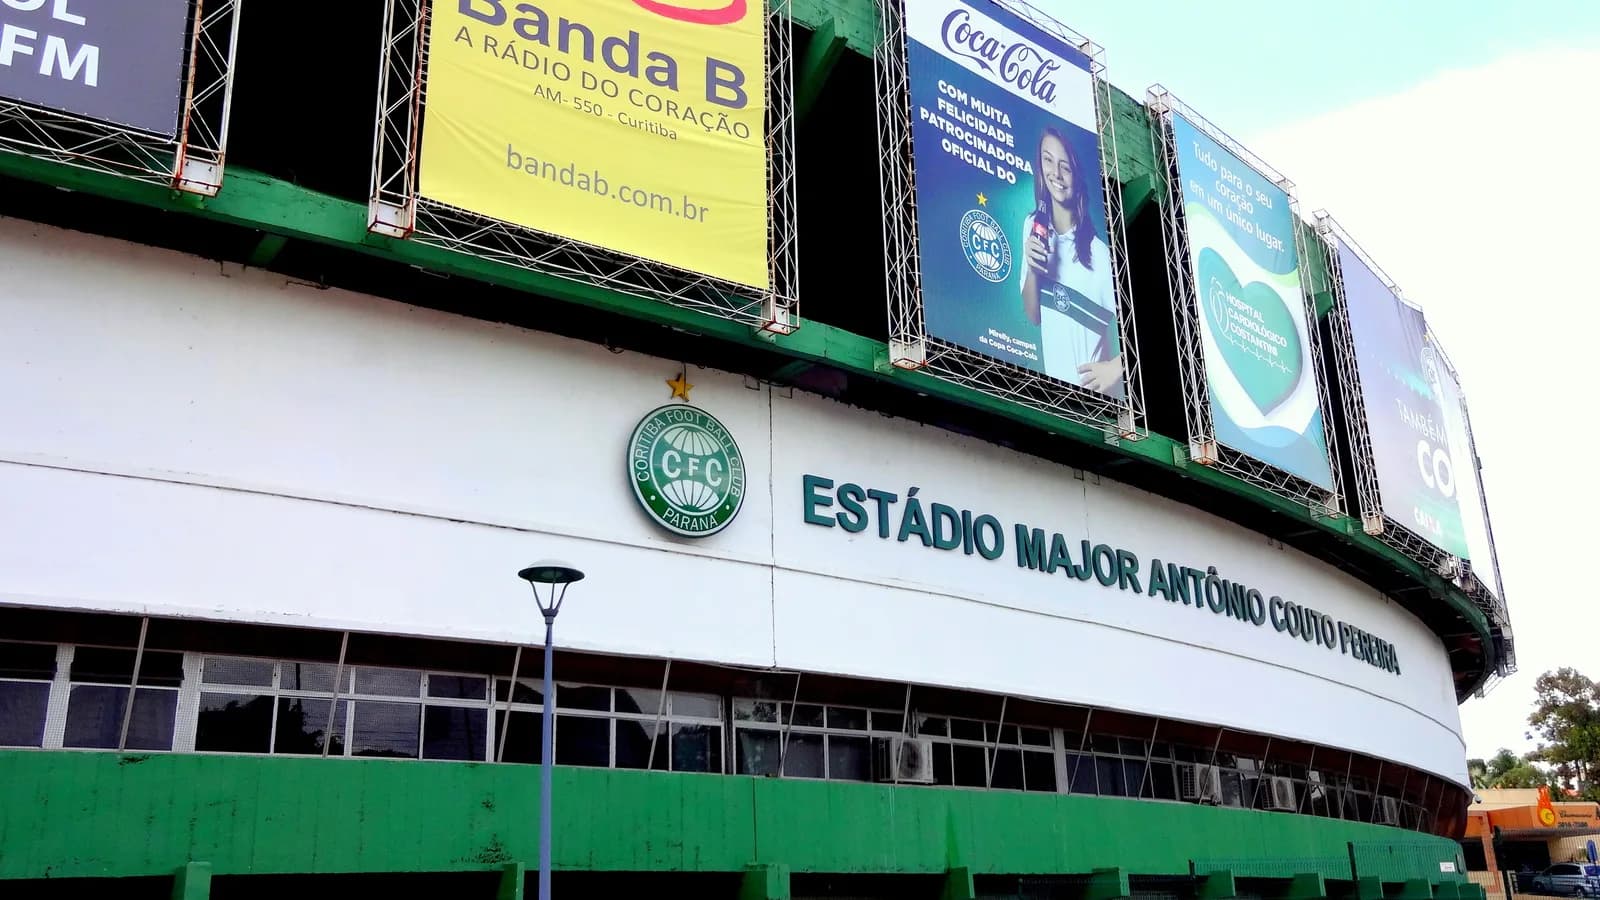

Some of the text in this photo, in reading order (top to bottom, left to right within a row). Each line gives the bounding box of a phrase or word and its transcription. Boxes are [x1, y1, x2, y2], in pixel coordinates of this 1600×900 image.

[1, 0, 86, 26] L
[0, 24, 99, 87] FM
[941, 9, 1061, 104] Coca-Cola
[454, 26, 750, 140] A RÁDIO DO CORAÇÃO
[706, 57, 748, 109] B
[938, 79, 1012, 128] COM MUITA
[573, 97, 603, 118] 550
[617, 112, 678, 140] Curitiba
[920, 106, 1034, 175] PATROCINADORA
[937, 97, 1015, 148] FELICIDADE
[506, 144, 710, 223] bandab.com.br
[941, 138, 1017, 185] OFICIAL DO
[1193, 141, 1273, 210] Tudo para o seu
[1189, 179, 1285, 253] em um único lugar.
[1216, 180, 1254, 215] coração
[972, 234, 1000, 259] CFC
[635, 410, 743, 498] CORITIBA FOOT BALL CLUB
[662, 450, 722, 487] CFC
[662, 507, 718, 531] PARANÁ
[803, 474, 1401, 675] ESTÁDIO MAJOR ANTÔNIO COUTO PEREIRA
